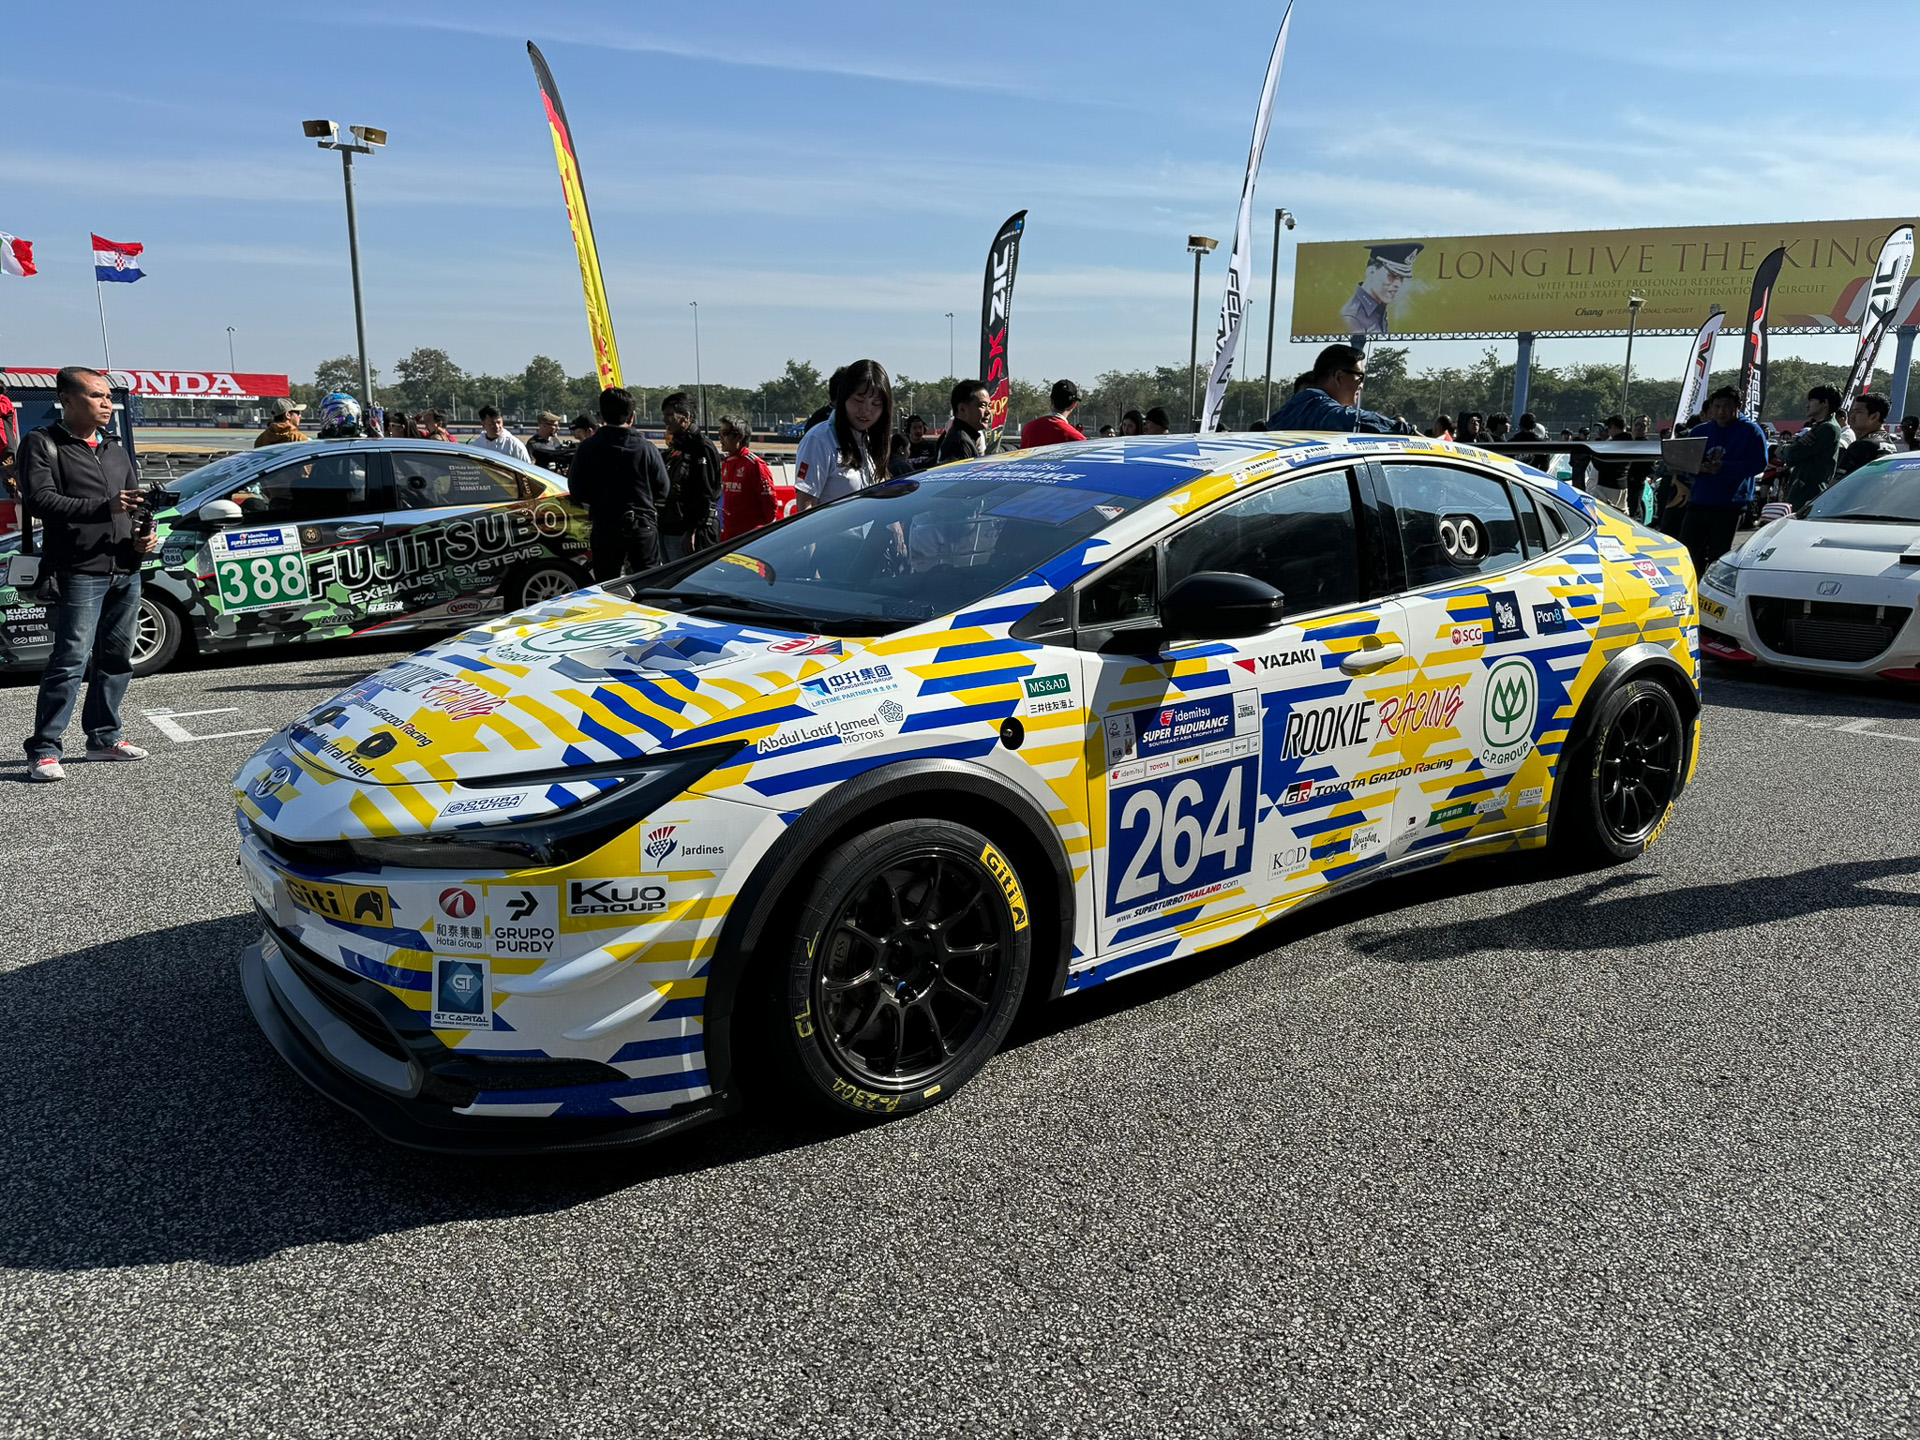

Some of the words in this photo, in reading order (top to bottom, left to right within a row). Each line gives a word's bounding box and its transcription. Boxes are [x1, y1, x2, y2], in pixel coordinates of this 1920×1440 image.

[1438, 248, 1548, 280] LONG
[1566, 244, 1655, 276] LIVE
[1671, 240, 1757, 272] THE
[989, 243, 1010, 326] ZIC
[1537, 281, 1567, 291] WITH
[1569, 280, 1591, 290] THE
[1593, 279, 1623, 289] MOST
[1626, 277, 1686, 289] PROFOUND
[1691, 275, 1737, 287] RESPECT
[1866, 256, 1902, 325] ZIC
[1488, 291, 1559, 301] MANAGEMENT
[1563, 290, 1587, 300] AND
[1590, 289, 1619, 298] STAFF
[1681, 284, 1750, 297] INTERNATIO
[1777, 284, 1827, 294] CIRCUIT
[1575, 307, 1604, 317] Chang
[1664, 306, 1693, 314] CIRCUIT
[987, 326, 1006, 382] SK
[110, 371, 246, 394] ONDA
[304, 502, 568, 600] FUJITSUBO
[220, 555, 305, 604] 388
[349, 569, 447, 605] EXHAUST
[453, 545, 544, 577] SYSTEMS
[460, 575, 495, 585] EXEDY
[6, 607, 47, 615] KUROKI
[450, 601, 479, 613] Queen
[7, 612, 46, 621] RACING
[18, 623, 49, 632] TEIN
[1463, 627, 1482, 642] SCG
[1258, 648, 1316, 671] YAZAKI
[828, 664, 891, 687] 中升集团
[834, 680, 874, 693] ZHONGSHENG
[874, 675, 894, 684] GROUP
[1028, 678, 1067, 693] MS&AD
[421, 679, 507, 721] RACING
[811, 696, 842, 708] LIFETIME
[842, 688, 873, 700] PARTNER
[1030, 698, 1075, 714] 三井住友海上
[1174, 707, 1211, 722] idemitsu
[1282, 700, 1375, 760] ROOKIE
[1376, 684, 1464, 738] RACING
[400, 723, 434, 748] Racing
[758, 731, 800, 752] Abdul
[801, 722, 832, 740] Latif
[835, 713, 880, 735] Jameel
[843, 729, 884, 744] MOTORS
[1142, 727, 1171, 743] SUPER
[1173, 715, 1230, 736] ENDURANCE
[1148, 737, 1180, 748] SOUTHEAST
[1180, 734, 1192, 742] ASIA
[1193, 729, 1213, 739] TROPHY
[1482, 741, 1530, 765] C.P.GROUP
[342, 755, 376, 778] Fuel
[1120, 767, 1143, 778] idemitsu
[1149, 761, 1170, 771] TOYOTA
[1285, 788, 1310, 804] GR
[1315, 777, 1366, 797] TOYOTA
[1369, 767, 1412, 785] GAZOO
[1414, 758, 1453, 775] Racing
[462, 801, 519, 812] CLUTCH
[467, 795, 520, 806] OGURA
[1115, 765, 1246, 905] 264
[681, 843, 724, 856] Jardines
[1272, 846, 1306, 870] KOD
[986, 852, 1016, 899] Giti
[285, 879, 341, 915] Giti
[570, 901, 666, 915] GROUP
[436, 923, 482, 939] 和泰集團
[494, 927, 555, 939] GRUPO
[436, 937, 457, 947] Hotai
[458, 938, 483, 950] Group
[496, 940, 554, 953] PURDY
[452, 974, 474, 990] GT
[433, 1013, 447, 1021] GT
[448, 1014, 489, 1023] CAPITAL
